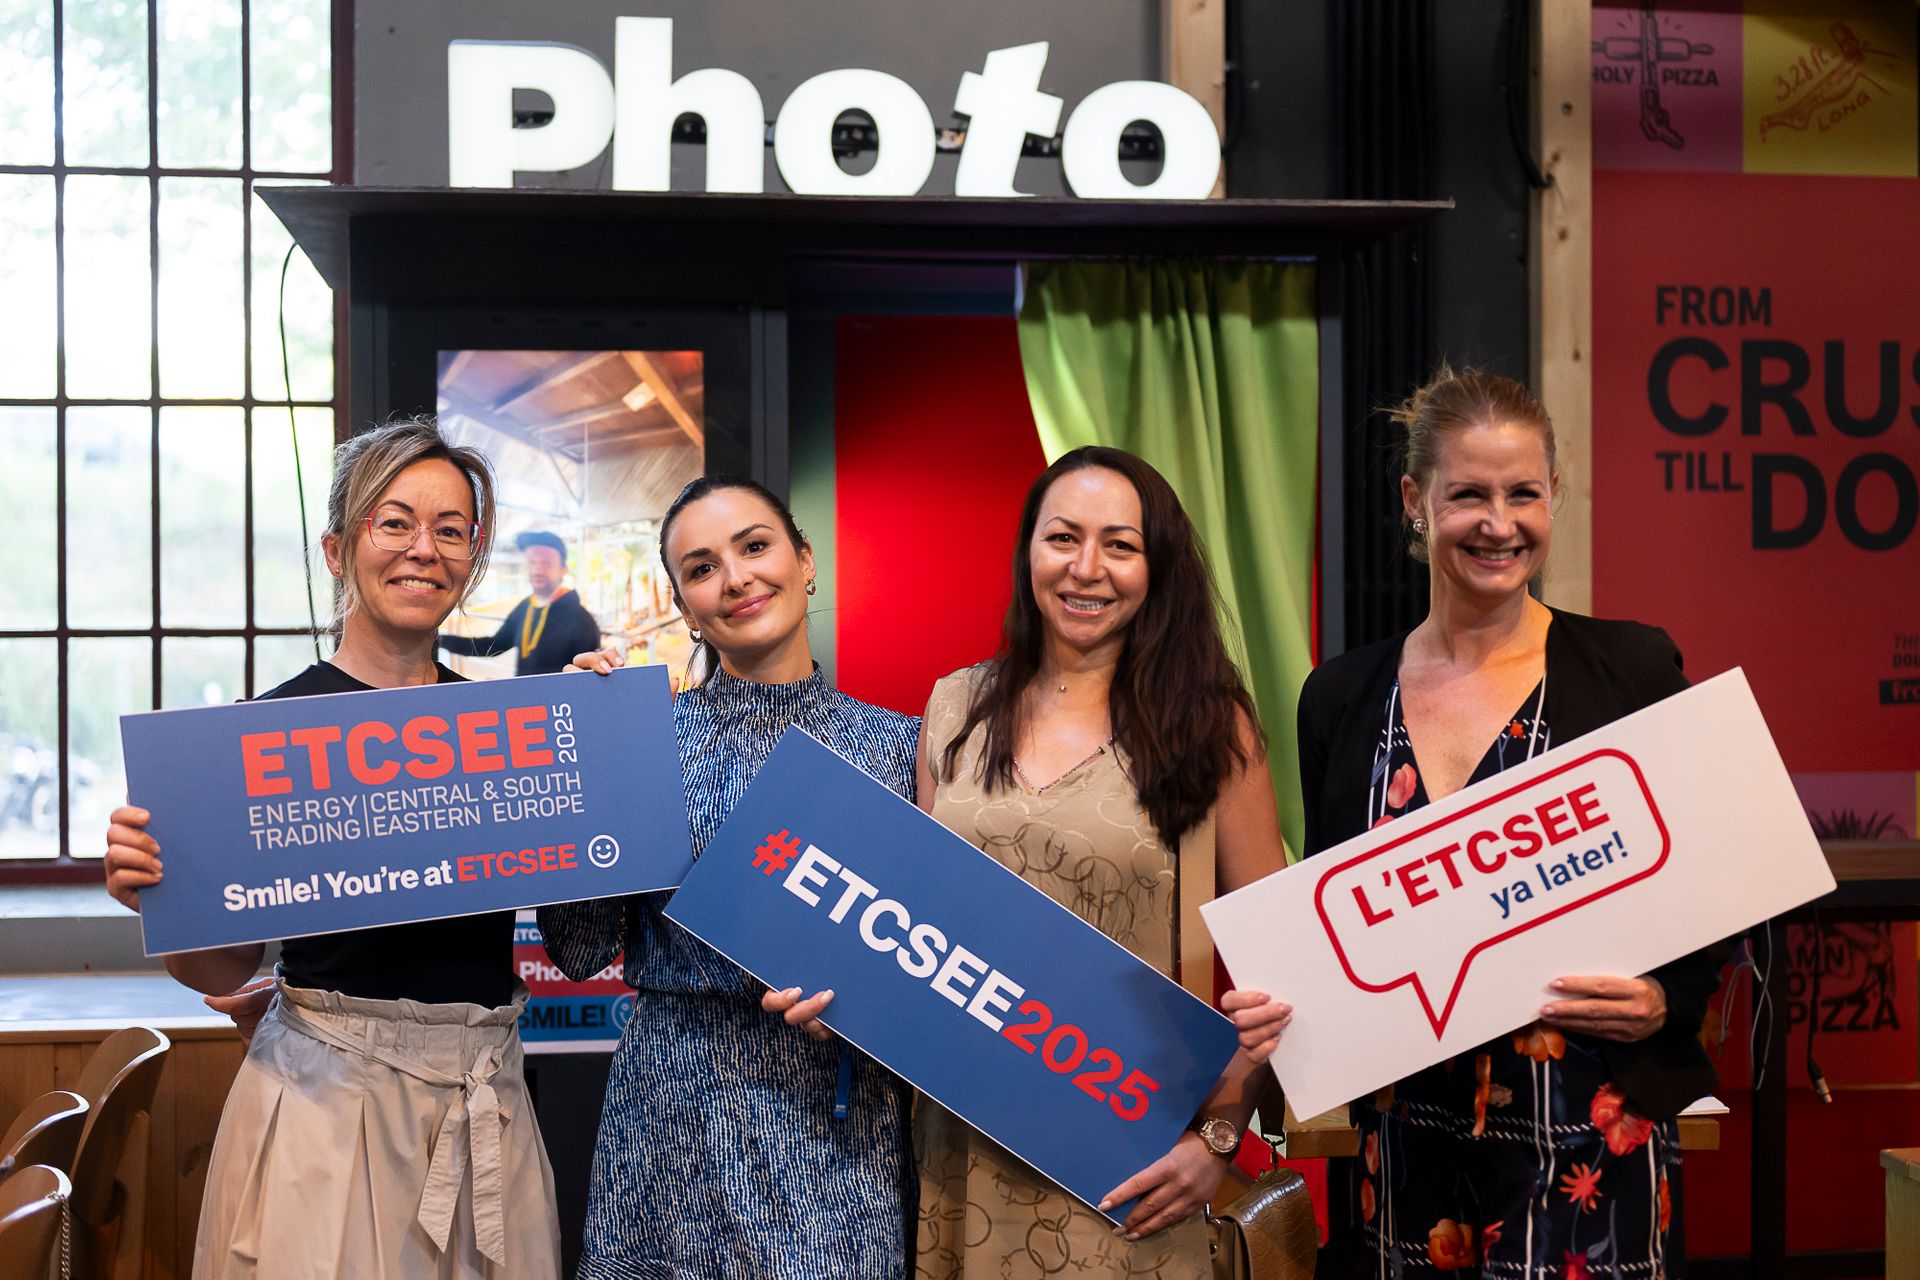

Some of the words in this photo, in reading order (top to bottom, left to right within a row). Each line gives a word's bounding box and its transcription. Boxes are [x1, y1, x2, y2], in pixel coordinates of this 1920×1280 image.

[448, 16, 1221, 198] Photo
[1662, 68, 1718, 87] PIZZA
[1656, 284, 1772, 326] FROM
[1647, 336, 1920, 438] CRU
[1655, 452, 1744, 491] TILL
[241, 705, 553, 797] ETCSEE
[552, 703, 578, 763] 2025
[249, 794, 357, 827] ENERGY
[371, 783, 479, 813] CENTRAL
[483, 781, 500, 801] &
[503, 771, 581, 798] SOUTH
[373, 806, 481, 836] EASTERN
[493, 793, 585, 823] EUROPE
[250, 819, 361, 850] TRADING
[1351, 782, 1610, 928] L'ETCSEE
[223, 876, 321, 912] Smile!
[323, 864, 420, 898] You're
[423, 860, 454, 887] at
[457, 843, 579, 882] ETCSEE
[1490, 880, 1534, 920] ya
[1536, 831, 1628, 891] later!
[751, 828, 1161, 1122] #ETCSEE2025
